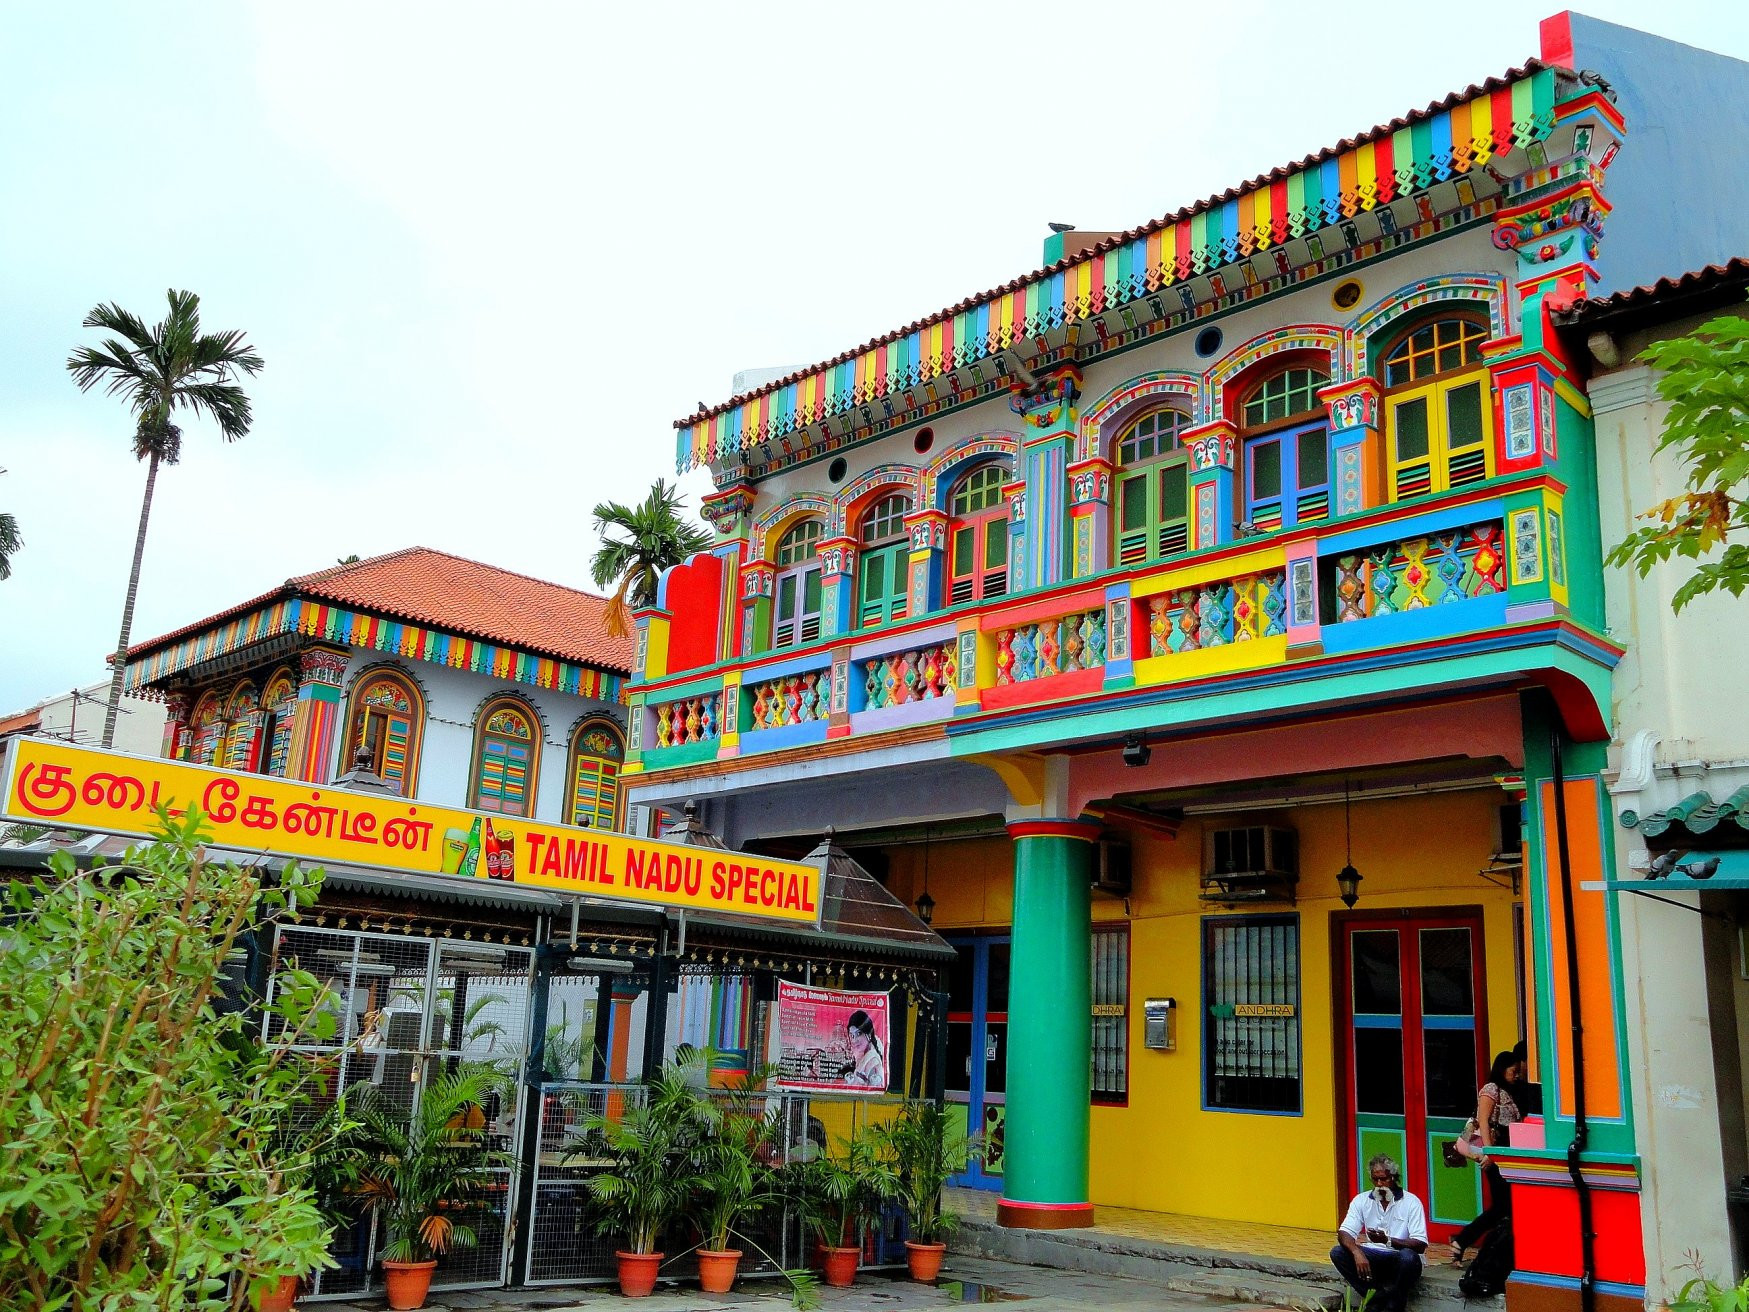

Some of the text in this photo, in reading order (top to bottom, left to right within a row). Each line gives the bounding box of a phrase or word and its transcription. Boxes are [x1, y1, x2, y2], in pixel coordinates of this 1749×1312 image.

[202, 777, 434, 852] கேன்டீன்
[525, 832, 814, 913] TAMIL NADU SPECIAL
[1238, 1005, 1291, 1015] ANDHRA
